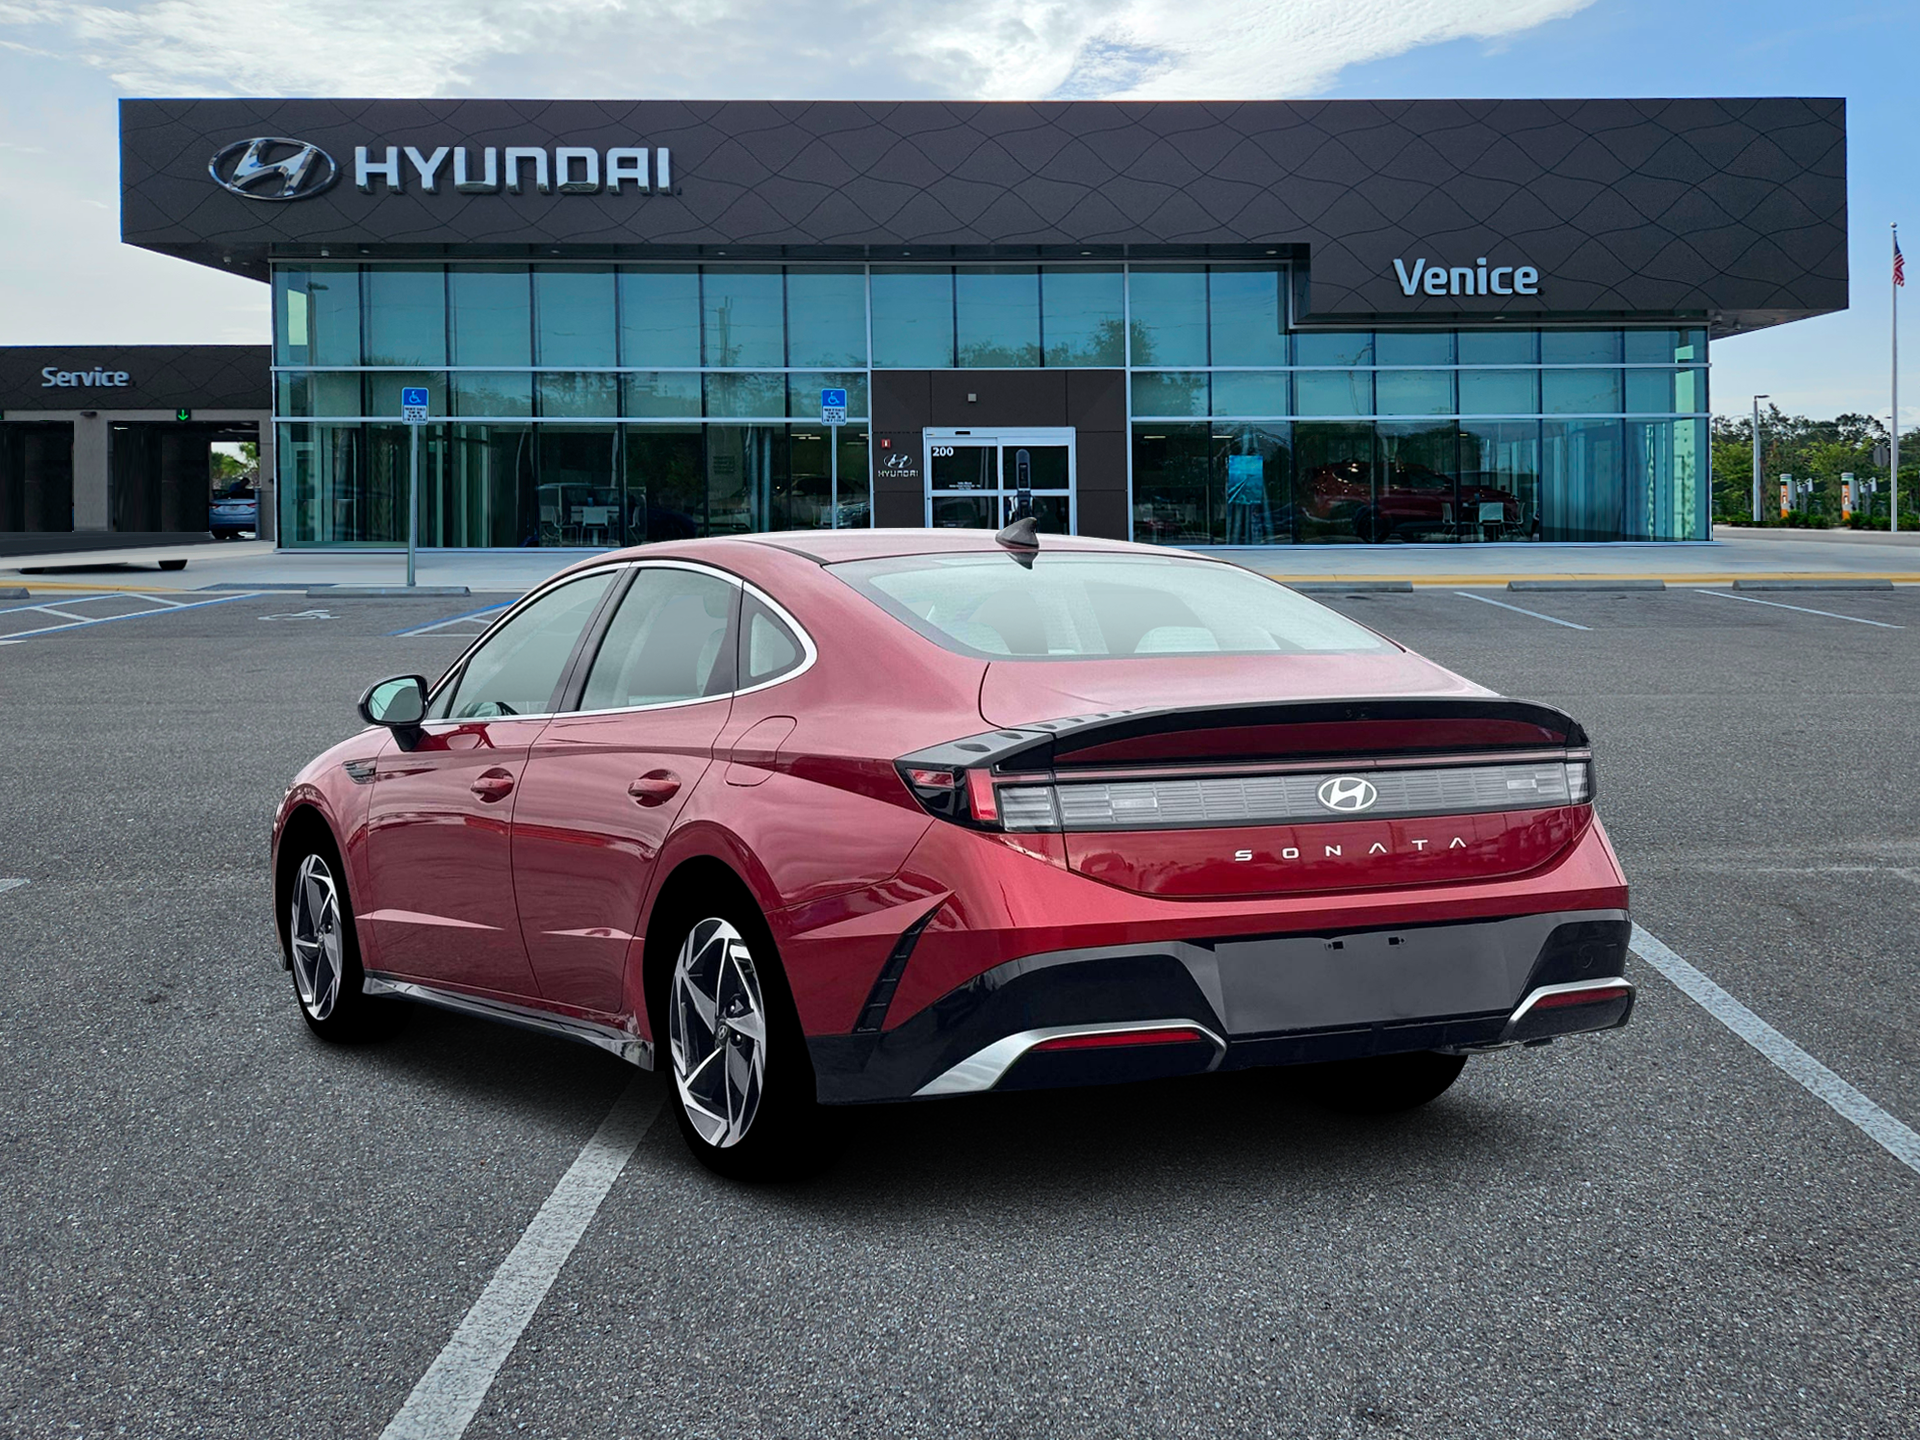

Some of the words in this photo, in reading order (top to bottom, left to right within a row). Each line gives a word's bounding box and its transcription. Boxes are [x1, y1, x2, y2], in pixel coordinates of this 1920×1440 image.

[355, 146, 672, 194] HYUNDAI
[1393, 257, 1539, 296] Venice
[41, 366, 130, 387] Service
[932, 446, 954, 457] 200
[877, 469, 919, 478] HYUNDAI
[1234, 837, 1467, 862] SONATA
